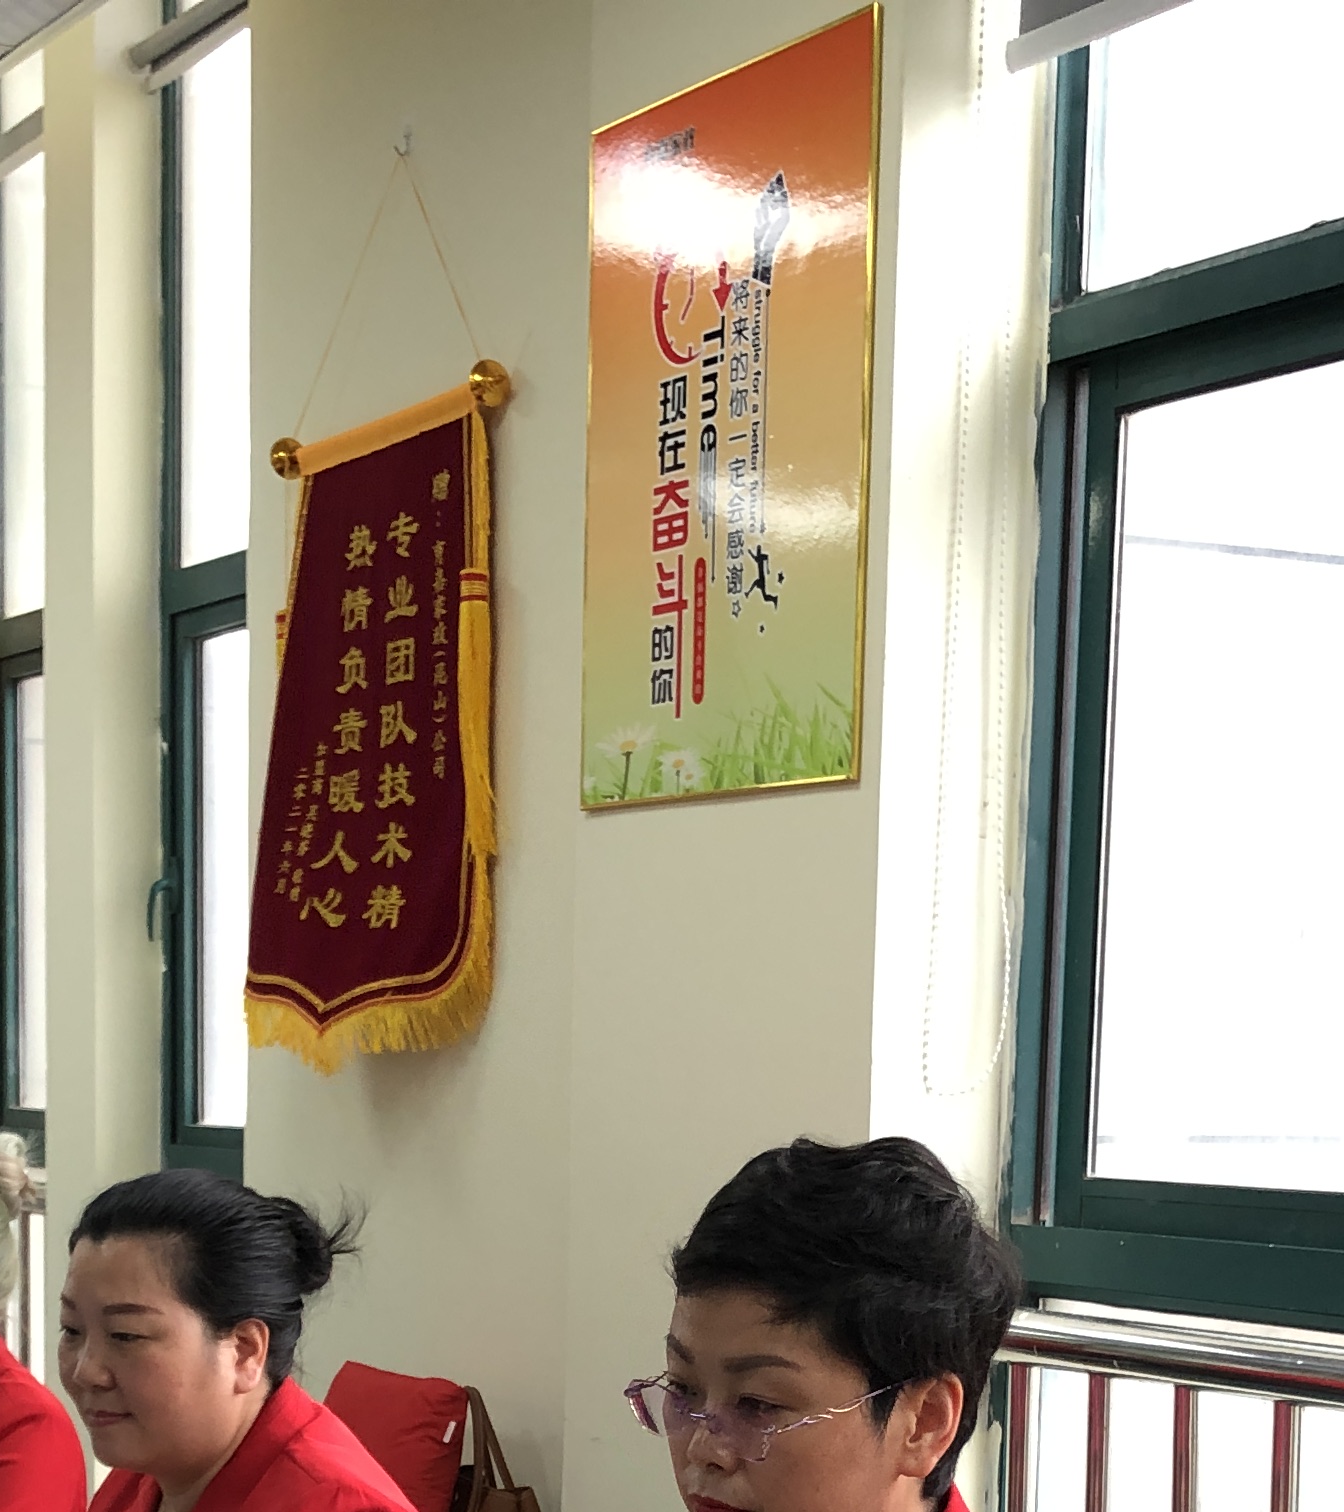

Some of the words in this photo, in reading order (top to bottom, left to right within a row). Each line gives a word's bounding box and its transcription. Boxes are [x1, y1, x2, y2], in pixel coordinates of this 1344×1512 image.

[700, 315, 725, 452] Time
[752, 289, 762, 363] struggle
[752, 369, 762, 395] for
[725, 279, 750, 596] 将来的你一定会感谢
[751, 420, 760, 472] better
[651, 374, 689, 718] 现在奋斗的你
[749, 480, 759, 535] future
[299, 523, 378, 929] 热情负责暖人心
[361, 511, 420, 931] 专业团队技术精
